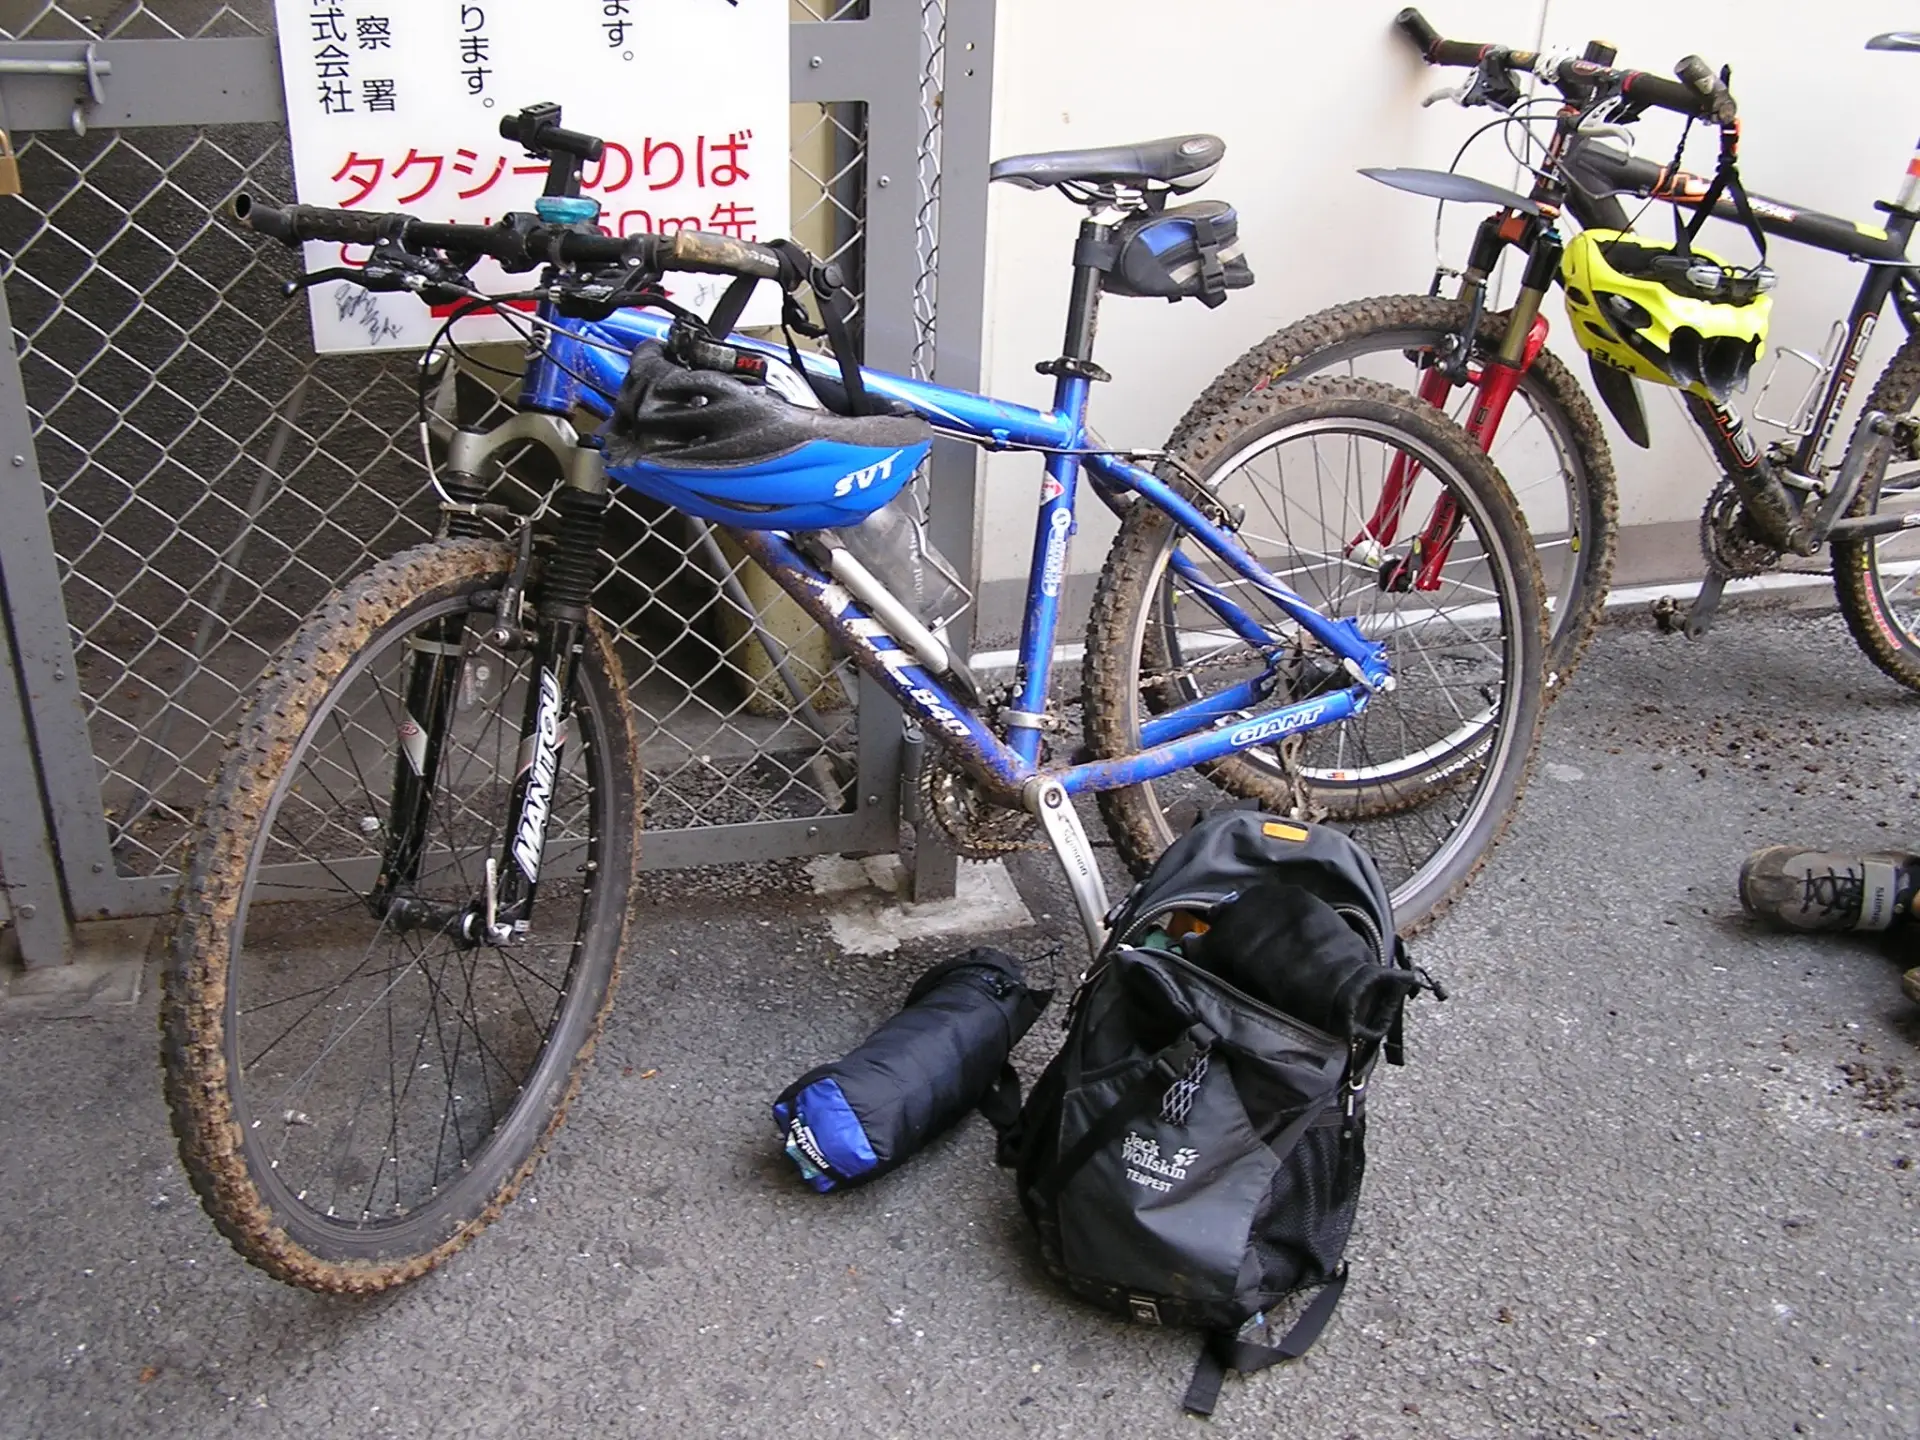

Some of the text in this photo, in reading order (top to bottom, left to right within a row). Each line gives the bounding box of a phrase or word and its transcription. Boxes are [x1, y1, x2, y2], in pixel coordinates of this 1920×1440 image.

[309, 0, 354, 114] 式会社
[834, 449, 904, 497] SVT
[1231, 704, 1326, 746] GIANT
[512, 666, 561, 884] MANITOU
[1121, 1143, 1187, 1180] Wolfskin
[1124, 1131, 1160, 1157] Jack
[1126, 1168, 1174, 1193] TEMPEST
